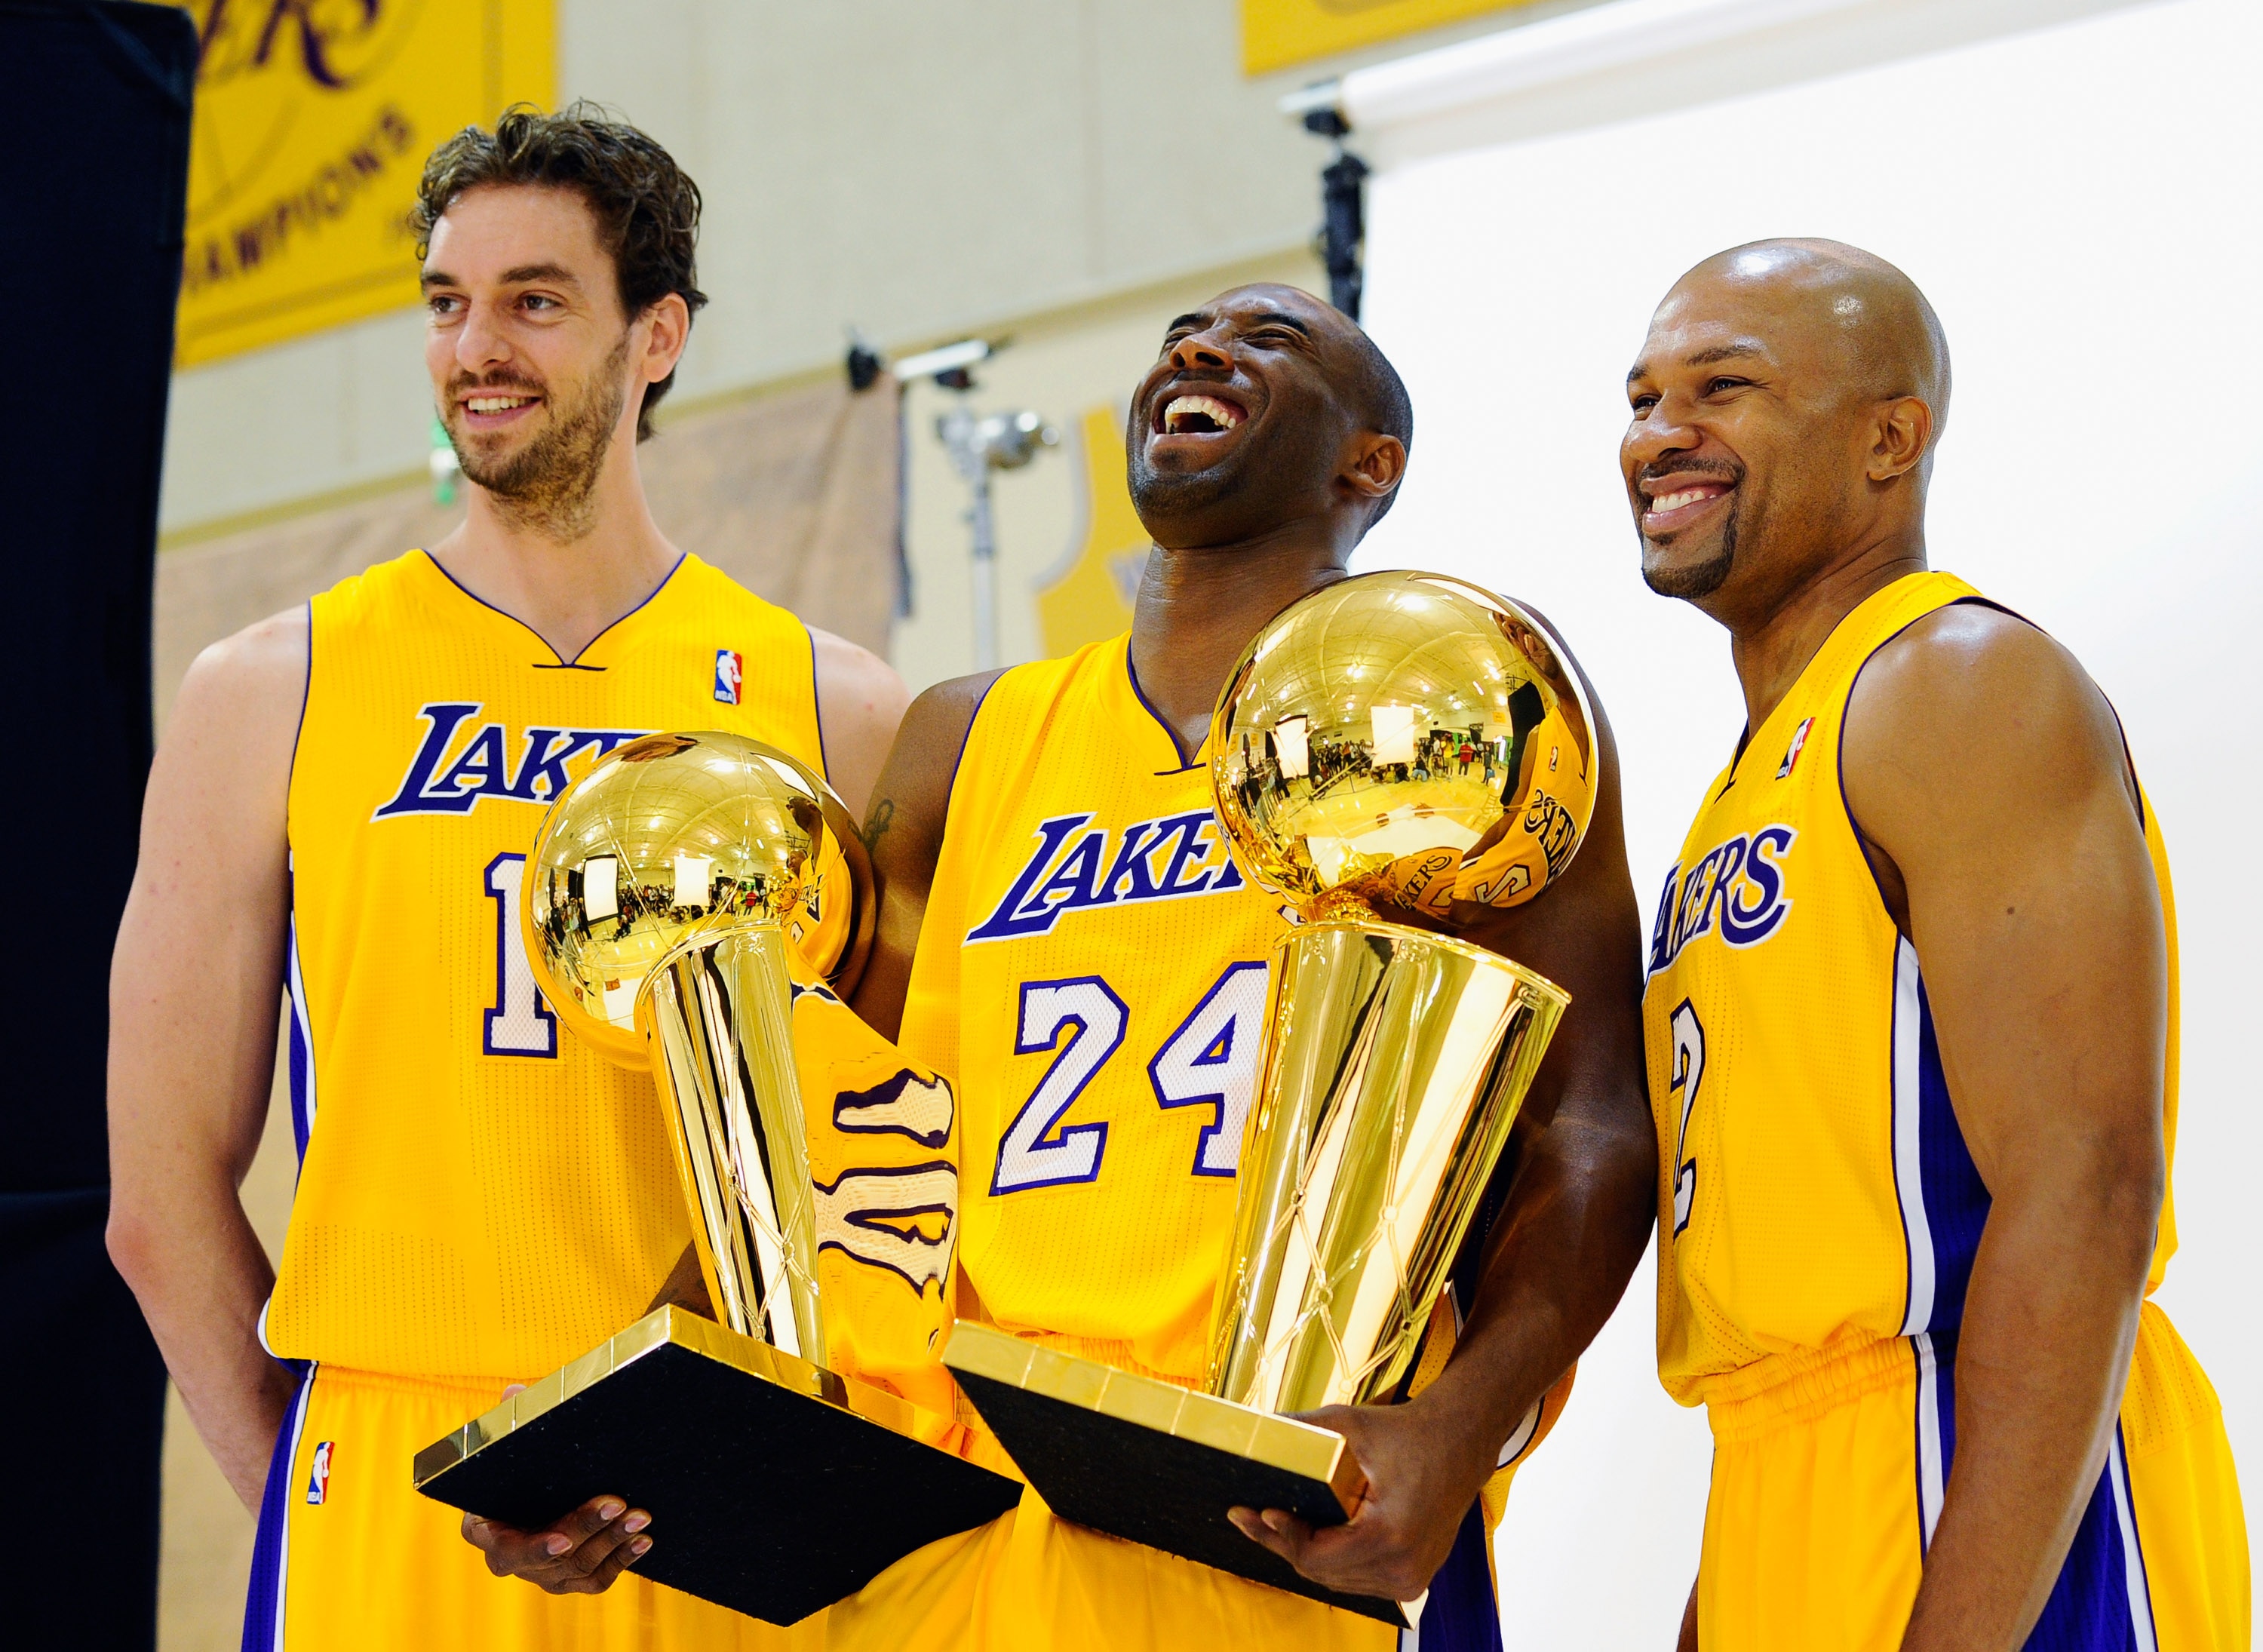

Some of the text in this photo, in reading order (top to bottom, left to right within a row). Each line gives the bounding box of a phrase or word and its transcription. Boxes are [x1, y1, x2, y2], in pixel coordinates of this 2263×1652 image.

[183, 106, 415, 291] AMPIONS
[369, 702, 664, 822] LAK
[961, 812, 1247, 947] LAKE
[988, 960, 1270, 1197] 24
